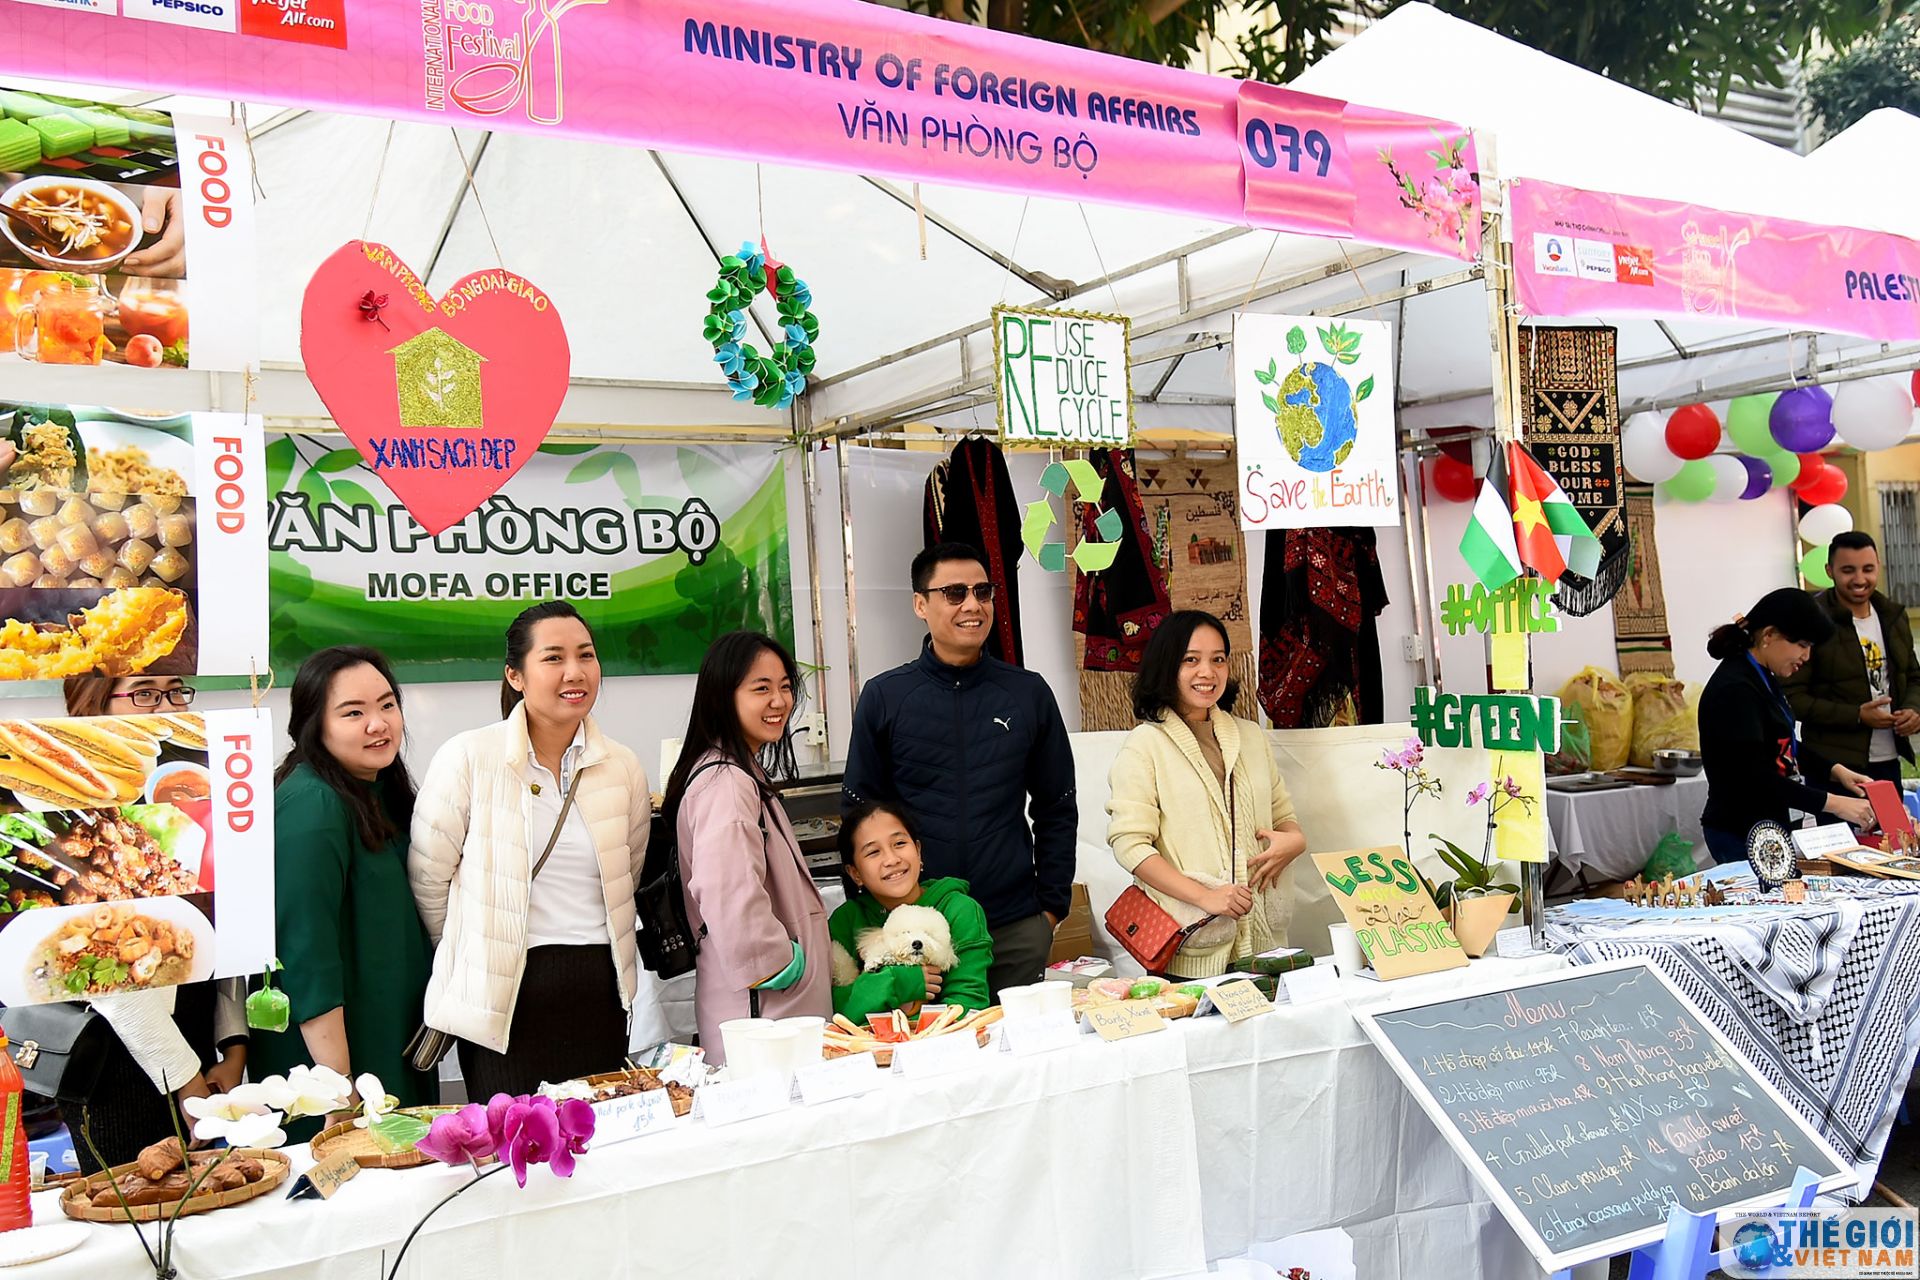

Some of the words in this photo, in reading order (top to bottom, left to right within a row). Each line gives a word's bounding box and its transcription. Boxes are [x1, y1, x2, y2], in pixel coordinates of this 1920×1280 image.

[445, 0, 495, 26] FOOD
[447, 24, 521, 72] Festival
[684, 18, 862, 81] MINISTRY
[875, 53, 922, 90] OF
[934, 63, 1077, 118] FOREIGN
[1087, 91, 1200, 136] AFFAIRS
[837, 98, 909, 146] VĂN
[921, 114, 1043, 164] PHÒNG
[1053, 132, 1098, 180] BỘ
[1245, 118, 1332, 177] 079
[195, 134, 232, 228] FOOD
[1054, 320, 1095, 358] USE
[1056, 358, 1109, 398] DUCE
[1059, 397, 1123, 440] CYCLE
[368, 437, 426, 470] XANH
[1548, 460, 1602, 473] BLESS
[1557, 445, 1591, 458] GOD
[213, 437, 245, 534] FOOD
[1241, 467, 1307, 524] Save
[1311, 475, 1329, 510] the
[1560, 476, 1593, 489] OUR
[1566, 491, 1603, 504] OME
[388, 494, 627, 555] PHÒNG
[634, 497, 721, 566] BỘ
[368, 572, 473, 598] MOFA
[485, 572, 609, 597] OFFICE
[223, 735, 254, 833] FOOD
[1326, 853, 1420, 897] LESS
[1356, 921, 1461, 960] PLASTIC
[1504, 992, 1567, 1028] Menu
[1574, 1054, 1591, 1072] 8
[1711, 1103, 1749, 1134] sweet
